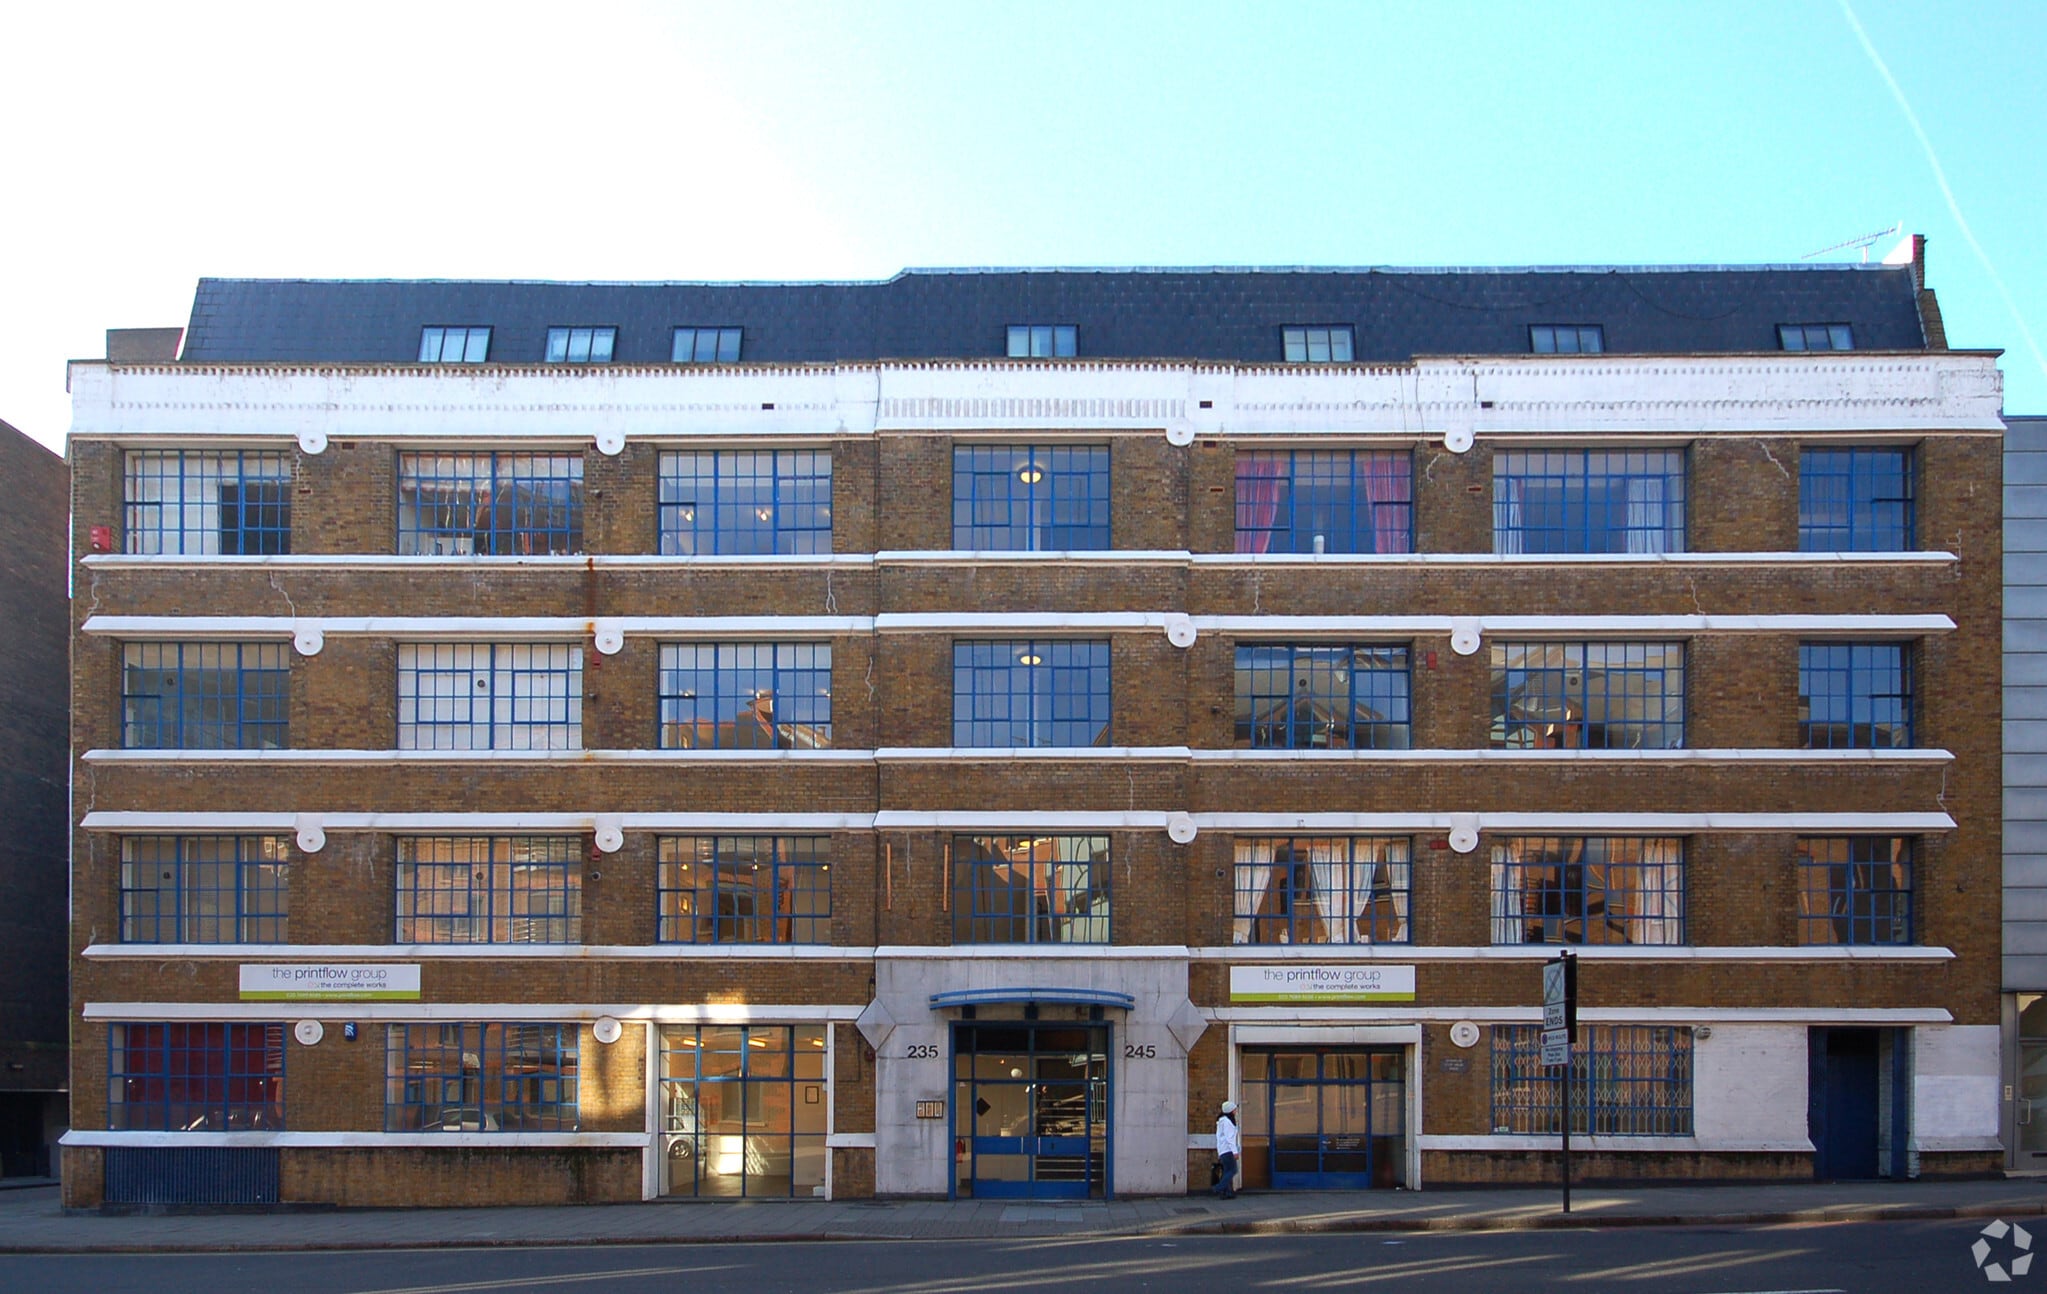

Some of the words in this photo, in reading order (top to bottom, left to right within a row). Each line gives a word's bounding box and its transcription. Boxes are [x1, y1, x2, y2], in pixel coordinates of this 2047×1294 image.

[272, 967, 292, 979] the
[295, 967, 348, 981] printflow
[351, 969, 387, 981] group
[1264, 968, 1283, 981] the
[1287, 968, 1341, 983] printflow
[1344, 970, 1381, 983] group
[333, 981, 365, 989] complete
[1325, 983, 1358, 991] complete
[1548, 1007, 1560, 1015] Zone
[1546, 1016, 1563, 1026] ENDS
[907, 1045, 939, 1059] 235
[1125, 1044, 1156, 1059] 245
